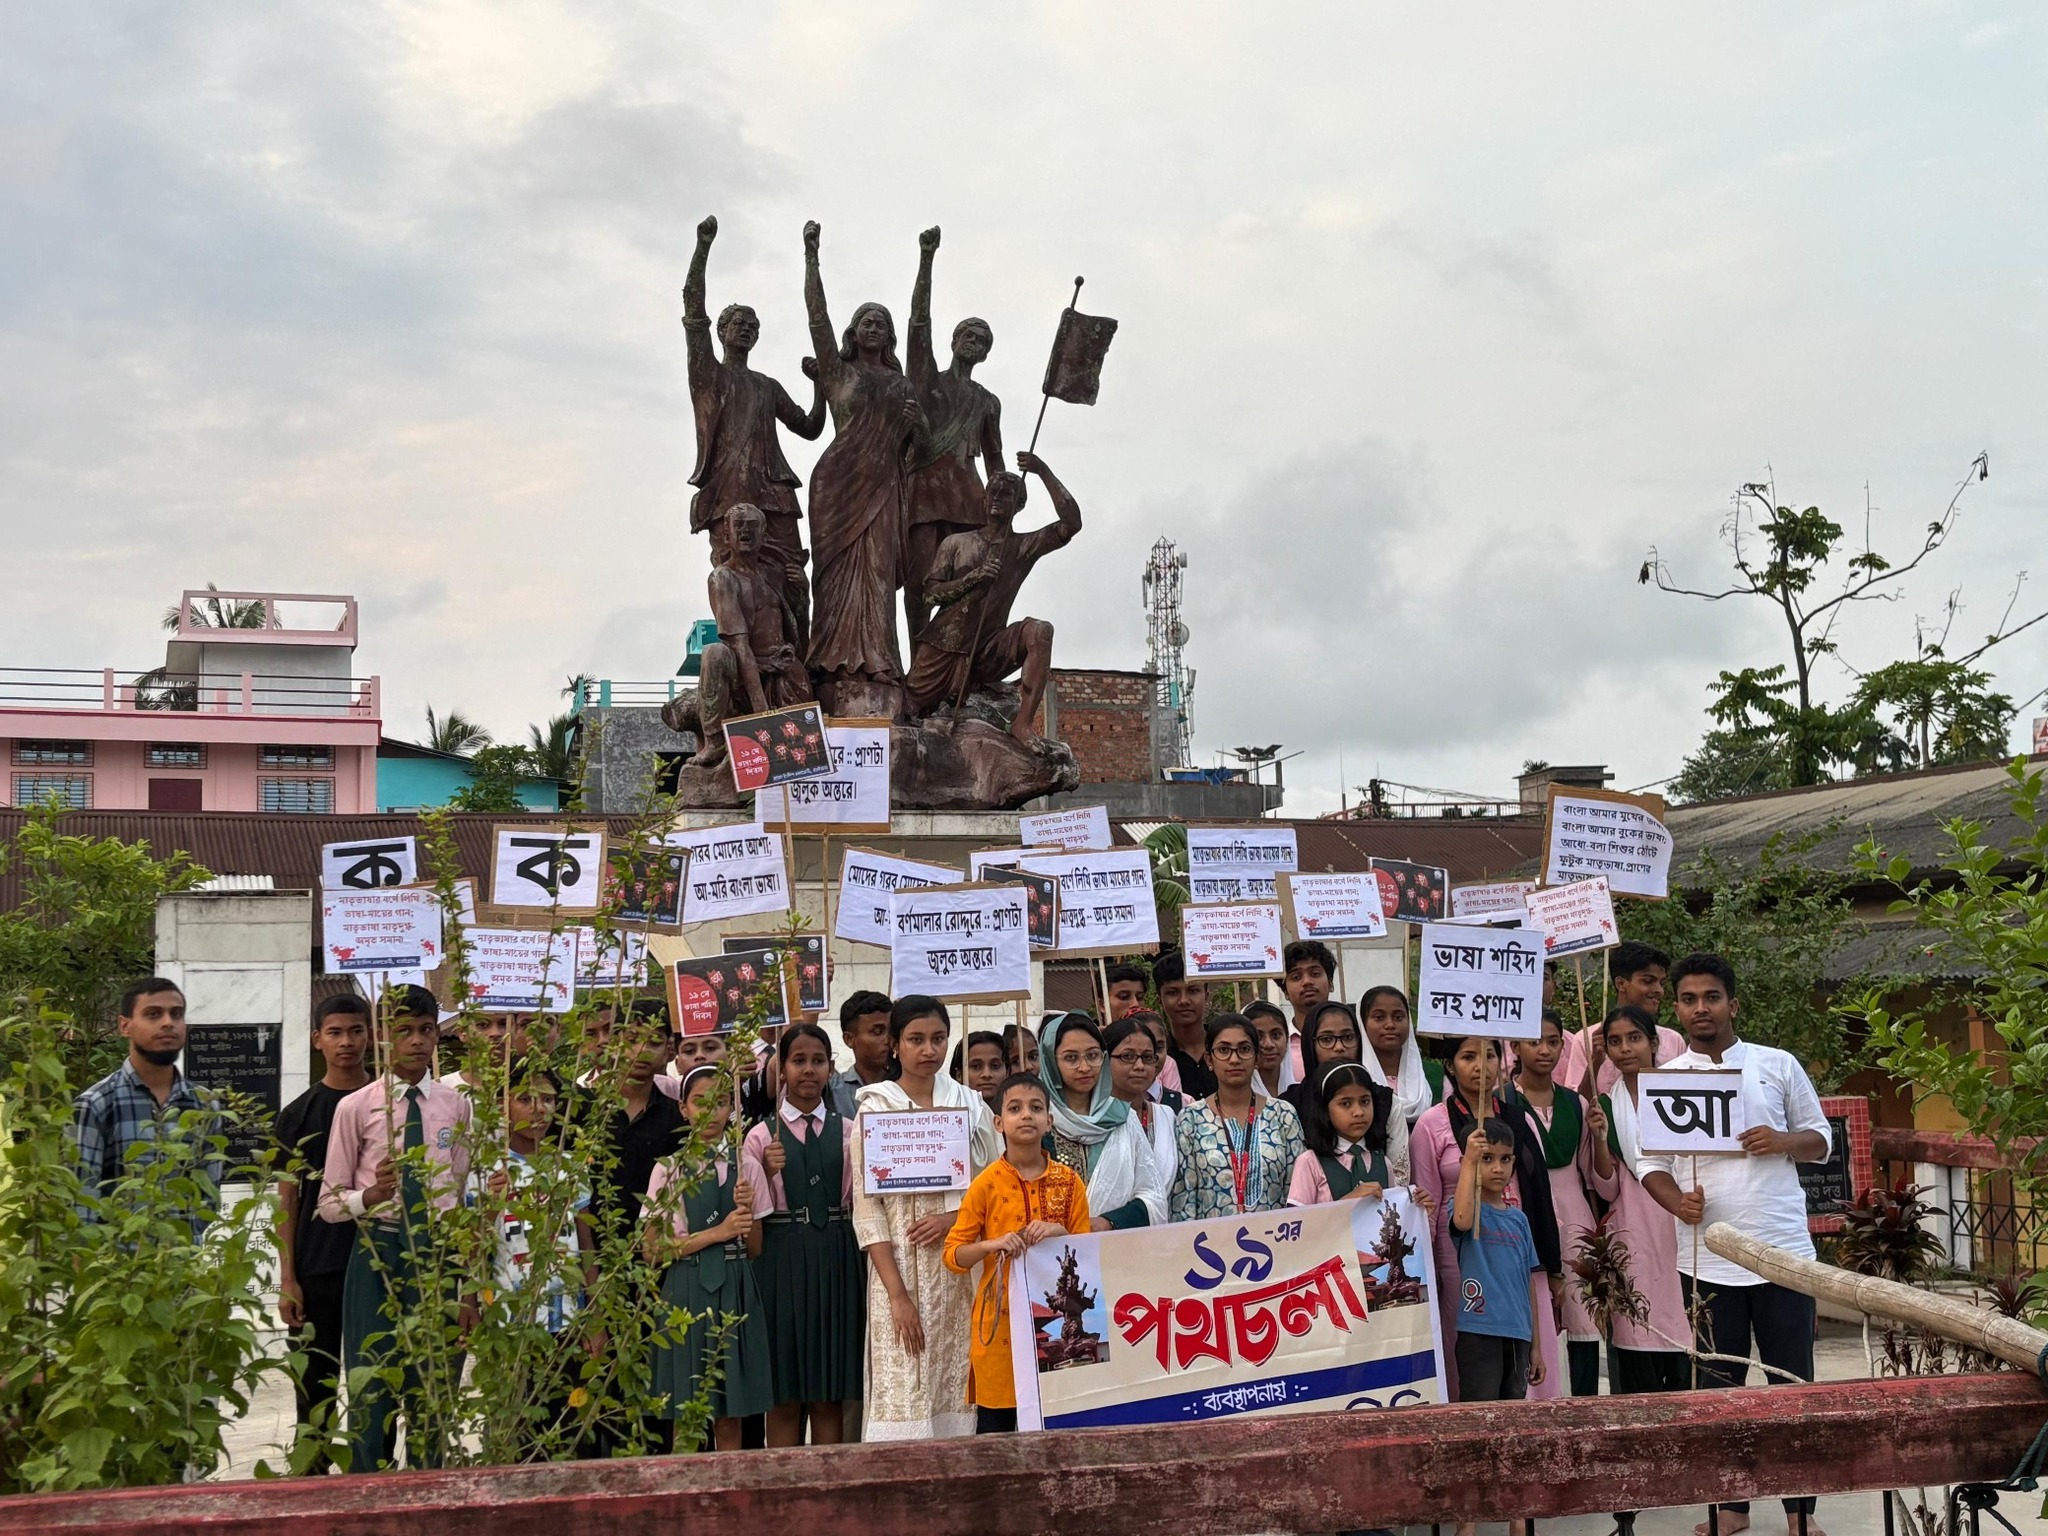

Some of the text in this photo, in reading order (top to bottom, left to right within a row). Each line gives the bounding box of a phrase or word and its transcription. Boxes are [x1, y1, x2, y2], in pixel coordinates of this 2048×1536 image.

[855, 741, 883, 767] প্রাণটা
[790, 781, 857, 804] জ্বলুক অন্তরে।
[1563, 804, 1587, 816] বাংলা
[1588, 808, 1617, 819] আমার
[1619, 811, 1644, 822] মুখের
[1562, 821, 1585, 833] বাংলা
[1587, 824, 1616, 836] আমার
[1618, 827, 1642, 839] বুকের
[713, 840, 744, 861] মোদের
[1247, 846, 1261, 860] ভাষা
[1608, 840, 1634, 855] শিশুর
[1637, 844, 1658, 858] ঠোঁটে
[333, 843, 407, 889] ক
[510, 837, 590, 898] ক
[1559, 854, 1583, 868] ফুটুক
[728, 876, 754, 897] বাংলা
[848, 865, 878, 886] মোদের
[880, 871, 898, 890] গরব
[1075, 867, 1091, 889] লিখি
[1091, 872, 1108, 888] ভাষা
[1108, 870, 1130, 887] মায়ের
[1194, 879, 1219, 897] মাতৃভাষা
[897, 905, 942, 933] বর্ণমালার
[945, 910, 981, 938] রোদ্দুরে
[993, 902, 1022, 931] প্রাণটা
[1093, 906, 1113, 926] অমৃত
[926, 947, 997, 975] জ্বলুক অন্তরে।
[1433, 943, 1485, 970] ভাষা
[1489, 941, 1537, 974] শহিদ
[700, 990, 710, 998] মে
[693, 1010, 712, 1020] দিবস
[1430, 991, 1524, 1023] লহ প্রণাম
[1646, 1089, 1738, 1138] আ
[1113, 1254, 1369, 1375] পথচলা
[1202, 1380, 1287, 1413] ব্যবস্থাপনায়
